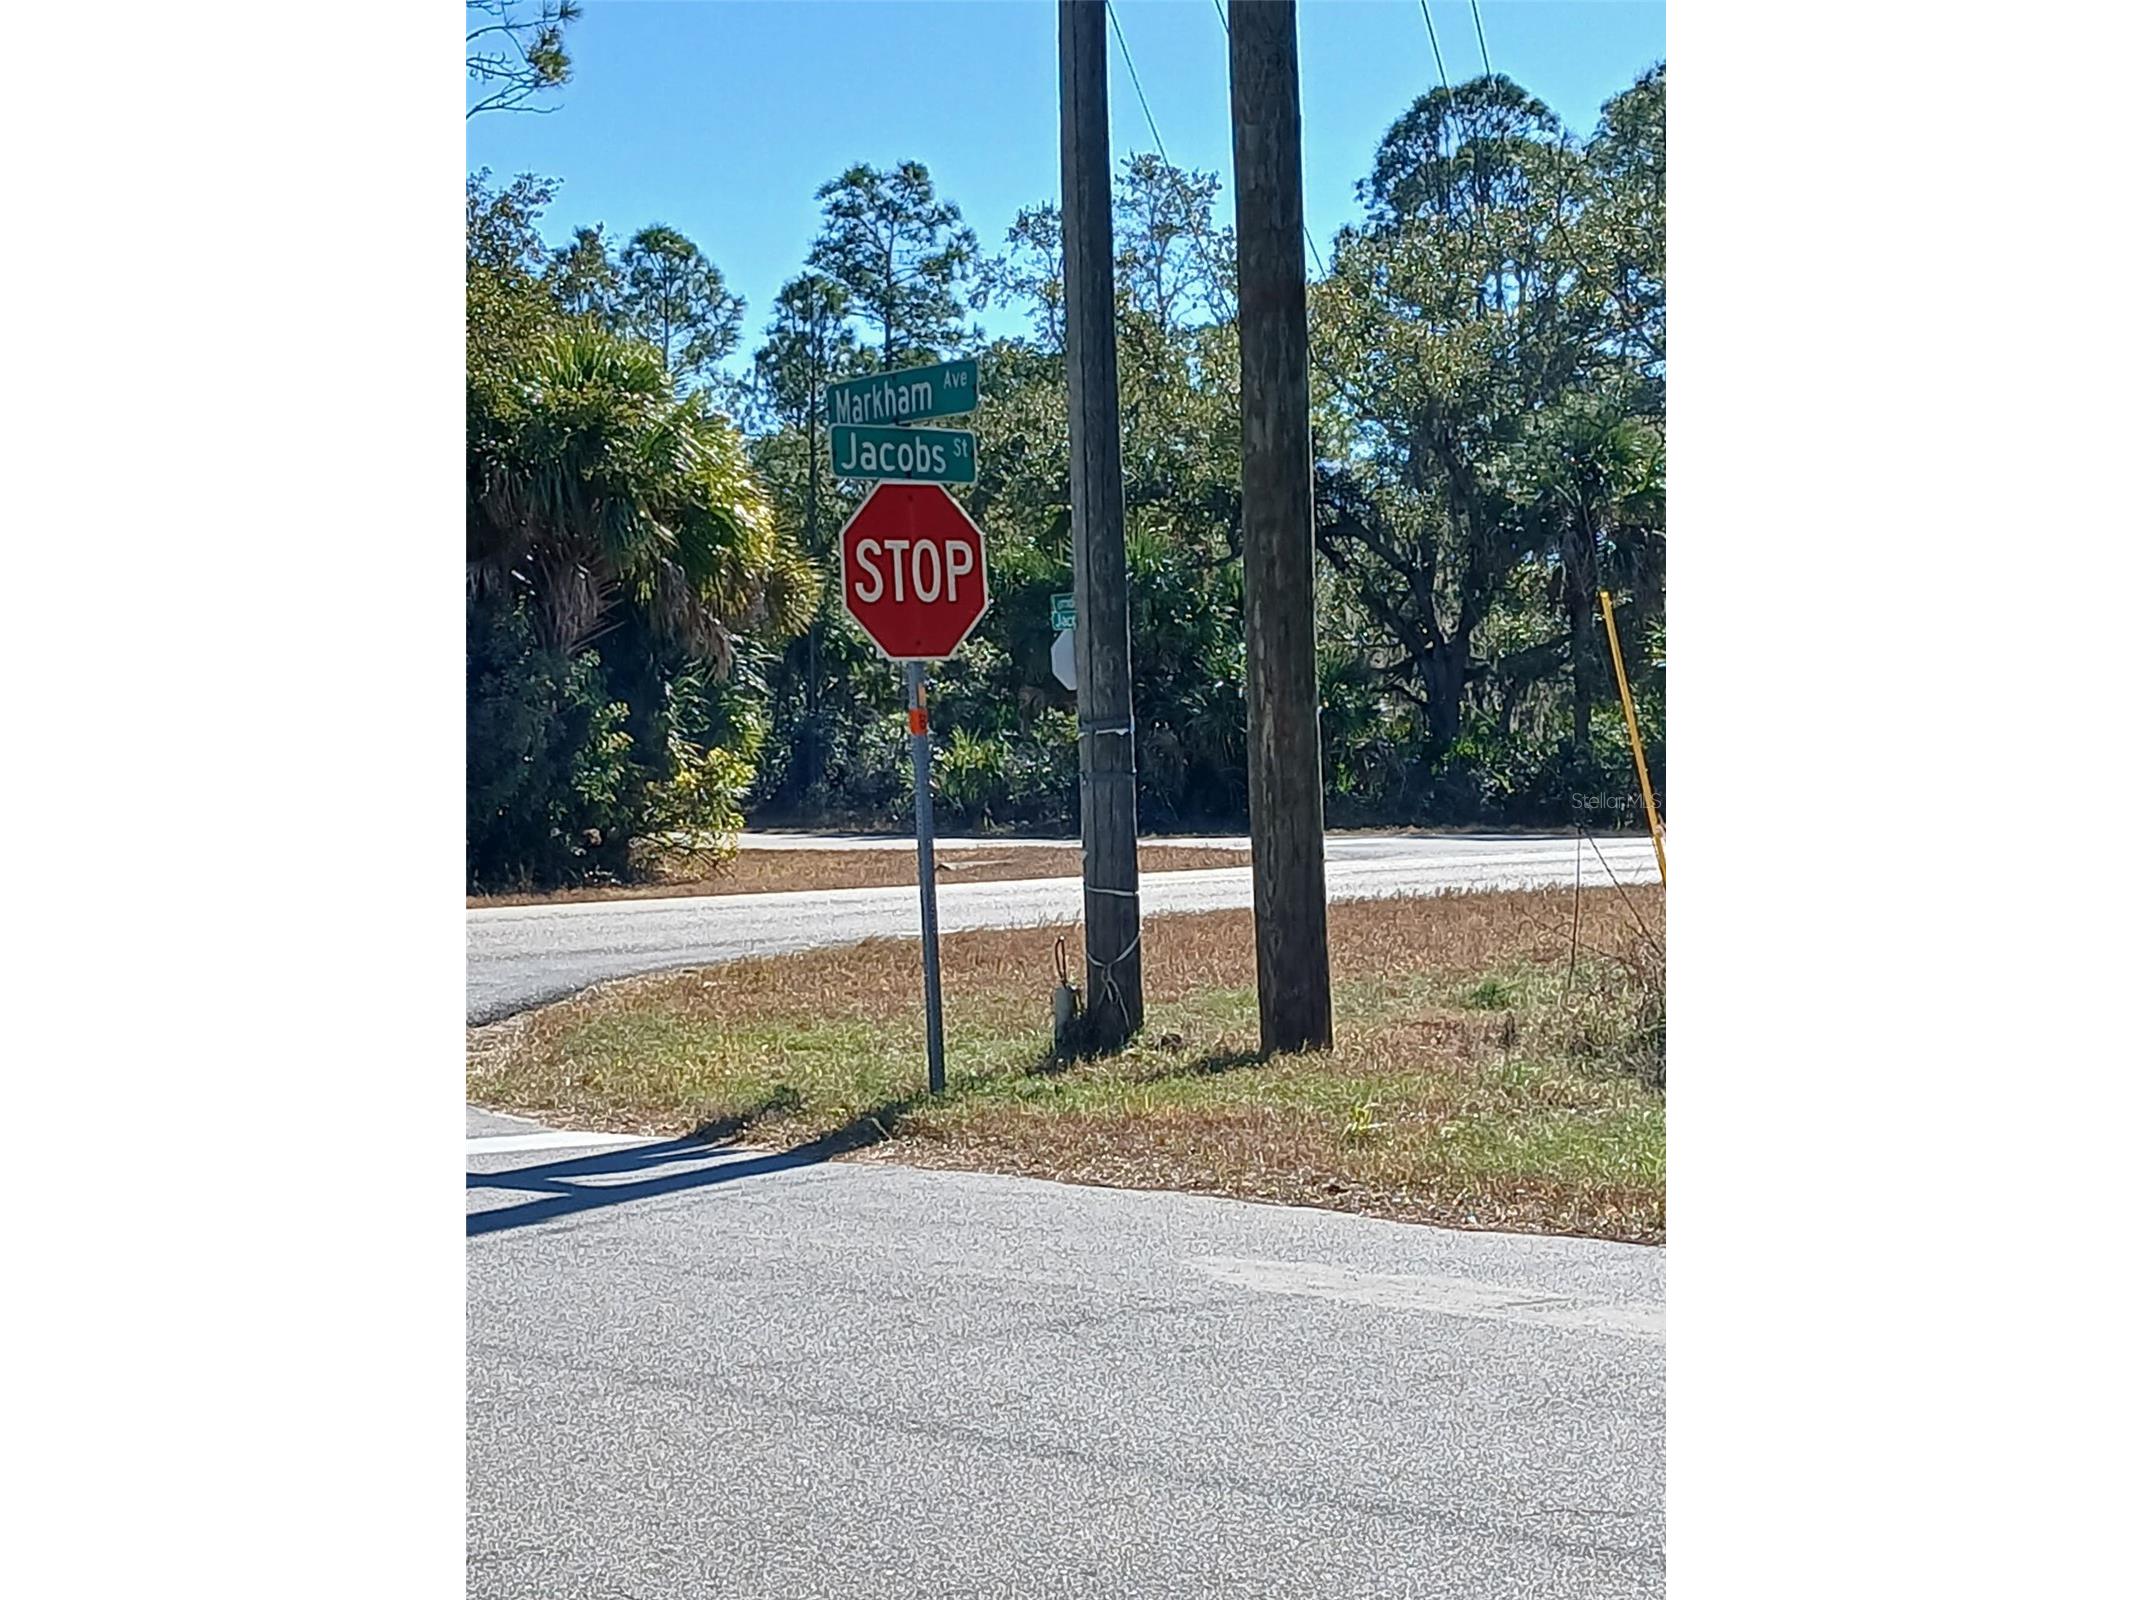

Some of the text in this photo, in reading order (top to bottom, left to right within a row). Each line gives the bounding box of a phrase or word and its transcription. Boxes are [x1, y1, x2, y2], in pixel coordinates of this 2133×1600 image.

[835, 369, 968, 425] Markham Ave
[841, 432, 969, 474] Jacobs St
[855, 538, 974, 604] STOP
